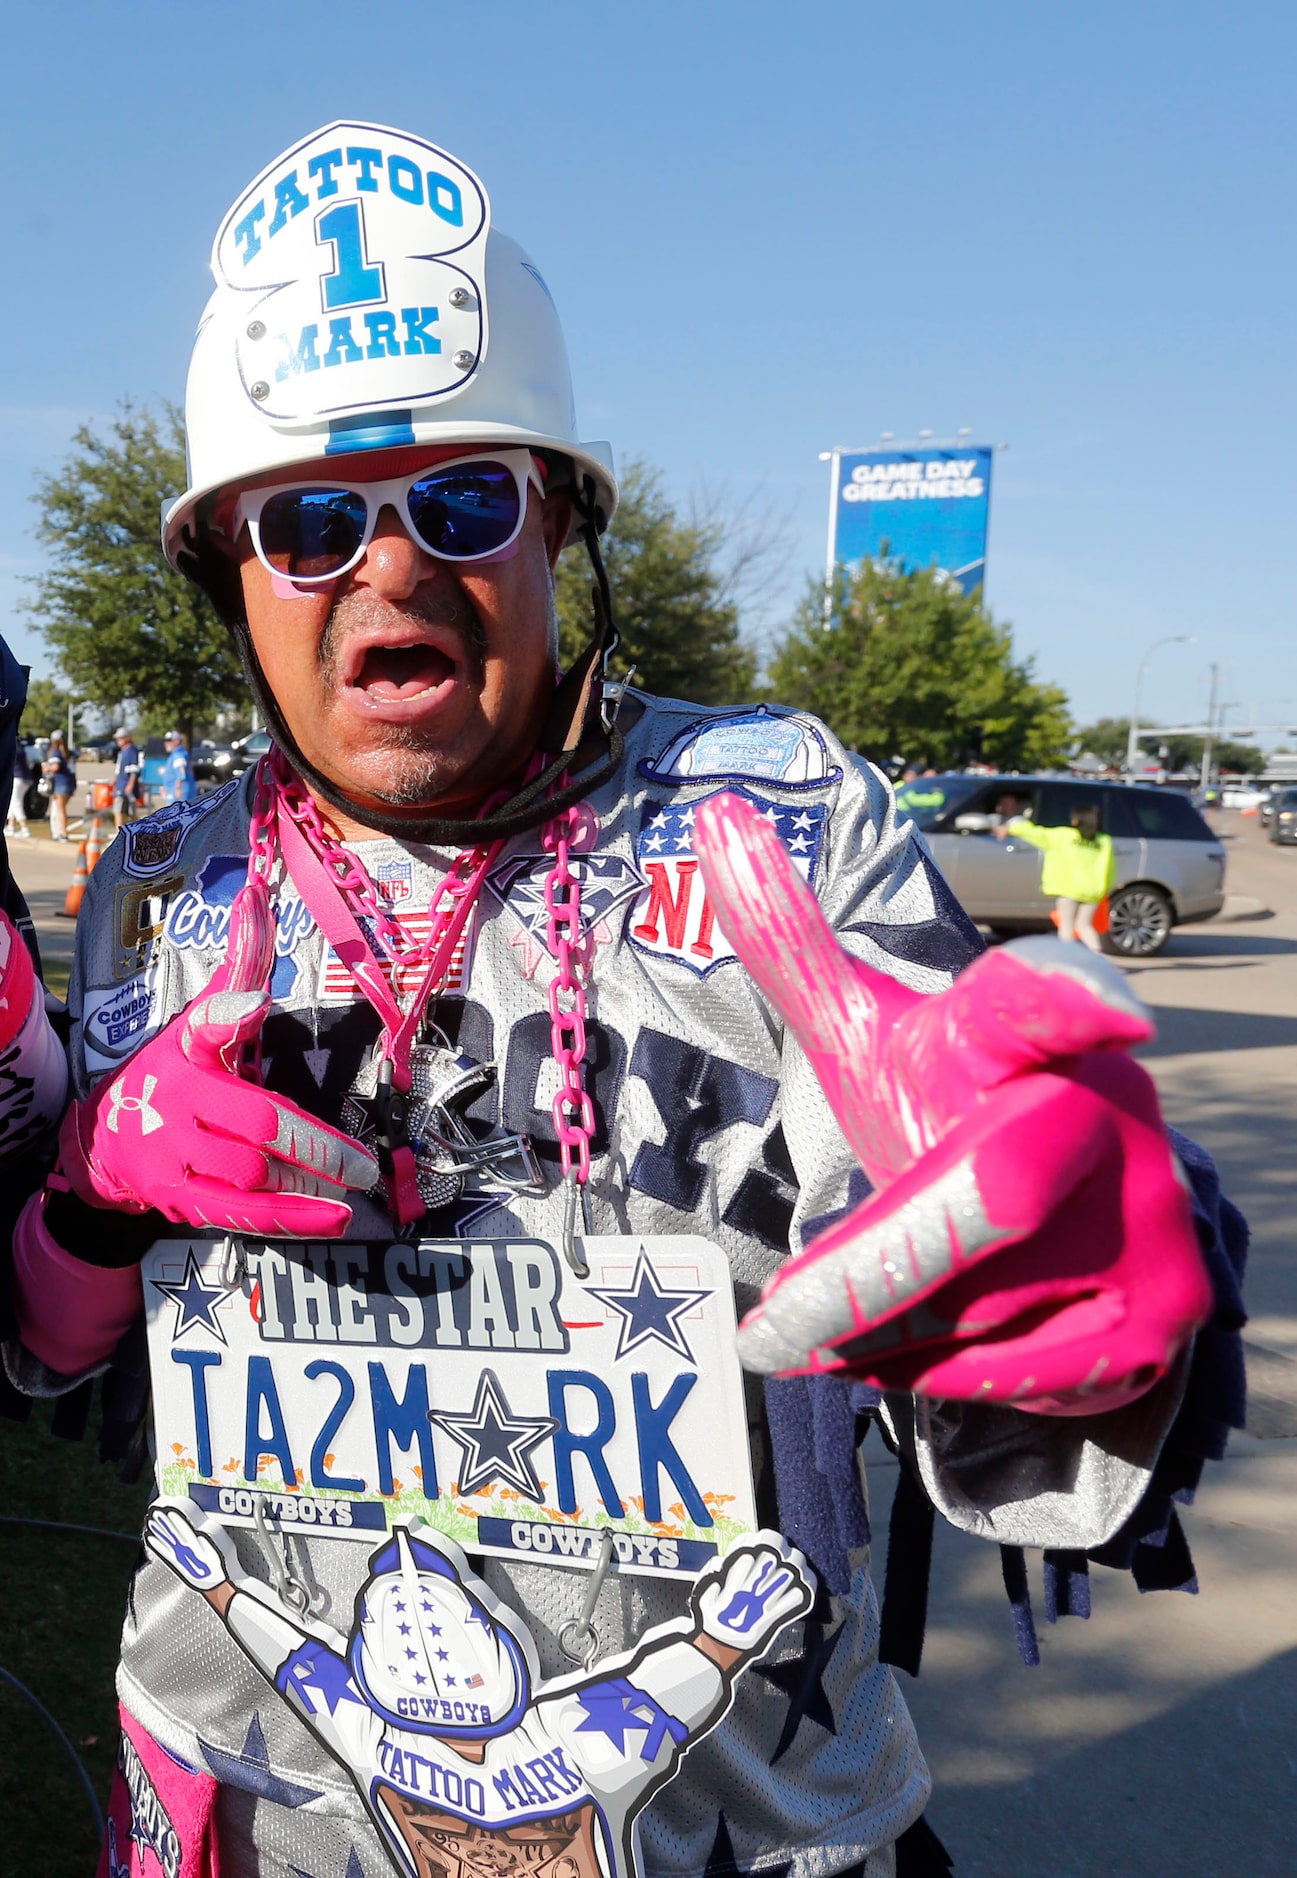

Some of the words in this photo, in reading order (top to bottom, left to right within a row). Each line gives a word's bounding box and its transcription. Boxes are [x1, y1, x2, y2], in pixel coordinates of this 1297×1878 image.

[234, 146, 464, 267] TATTOO
[315, 197, 388, 314] 1
[273, 306, 442, 382] MARK
[842, 477, 984, 503] GREATNESS
[852, 461, 923, 483] GAME
[926, 459, 977, 479] DAY
[381, 881, 409, 900] NFL
[253, 1244, 375, 1343] THE
[387, 1242, 567, 1352] STAR
[396, 1697, 492, 1724] COWBOYS
[378, 1740, 486, 1817] TATTOO
[492, 1746, 583, 1811] MARK
